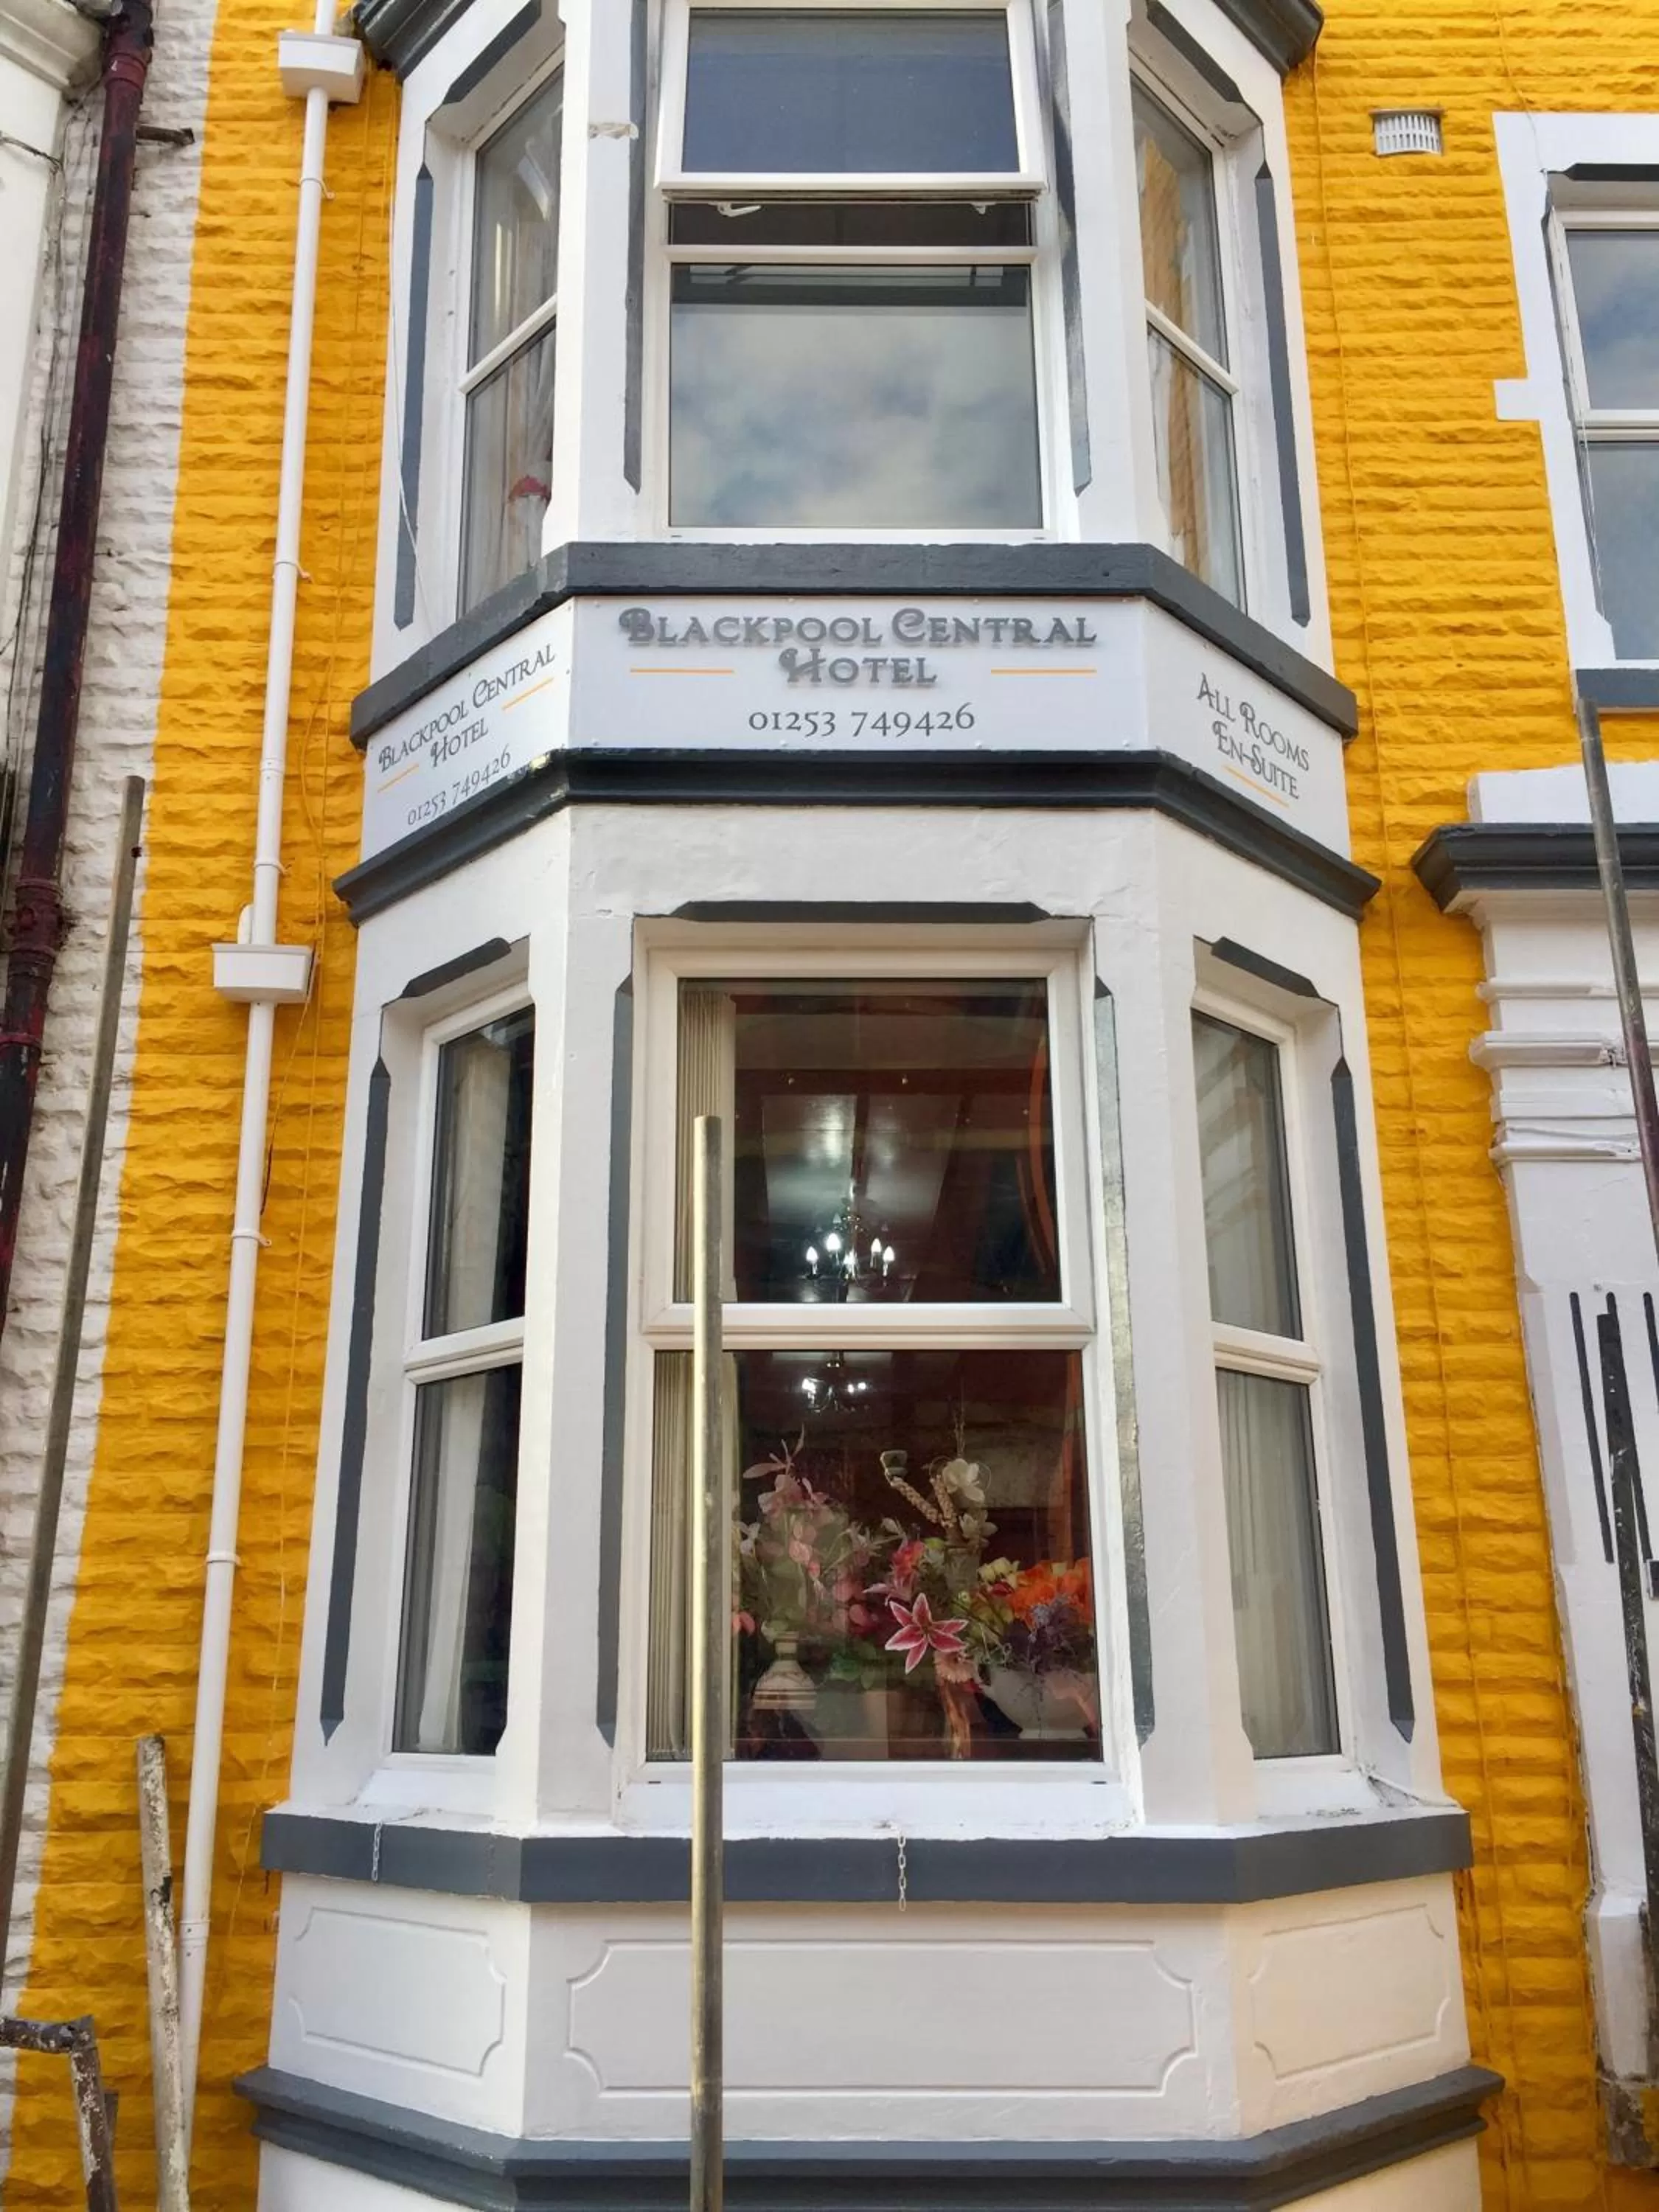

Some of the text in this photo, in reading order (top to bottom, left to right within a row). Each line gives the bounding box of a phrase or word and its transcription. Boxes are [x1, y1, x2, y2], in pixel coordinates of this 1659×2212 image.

[619, 608, 1097, 645] BLACKPOOL CENTRAL
[778, 648, 937, 686] HOTEL
[379, 644, 555, 772] BLACKPOOL CENTRAL
[748, 703, 975, 737] 01253 749426
[1196, 672, 1310, 771] ALL ROOMS
[430, 717, 489, 769] HOTEL
[408, 744, 511, 825] 01253 749426
